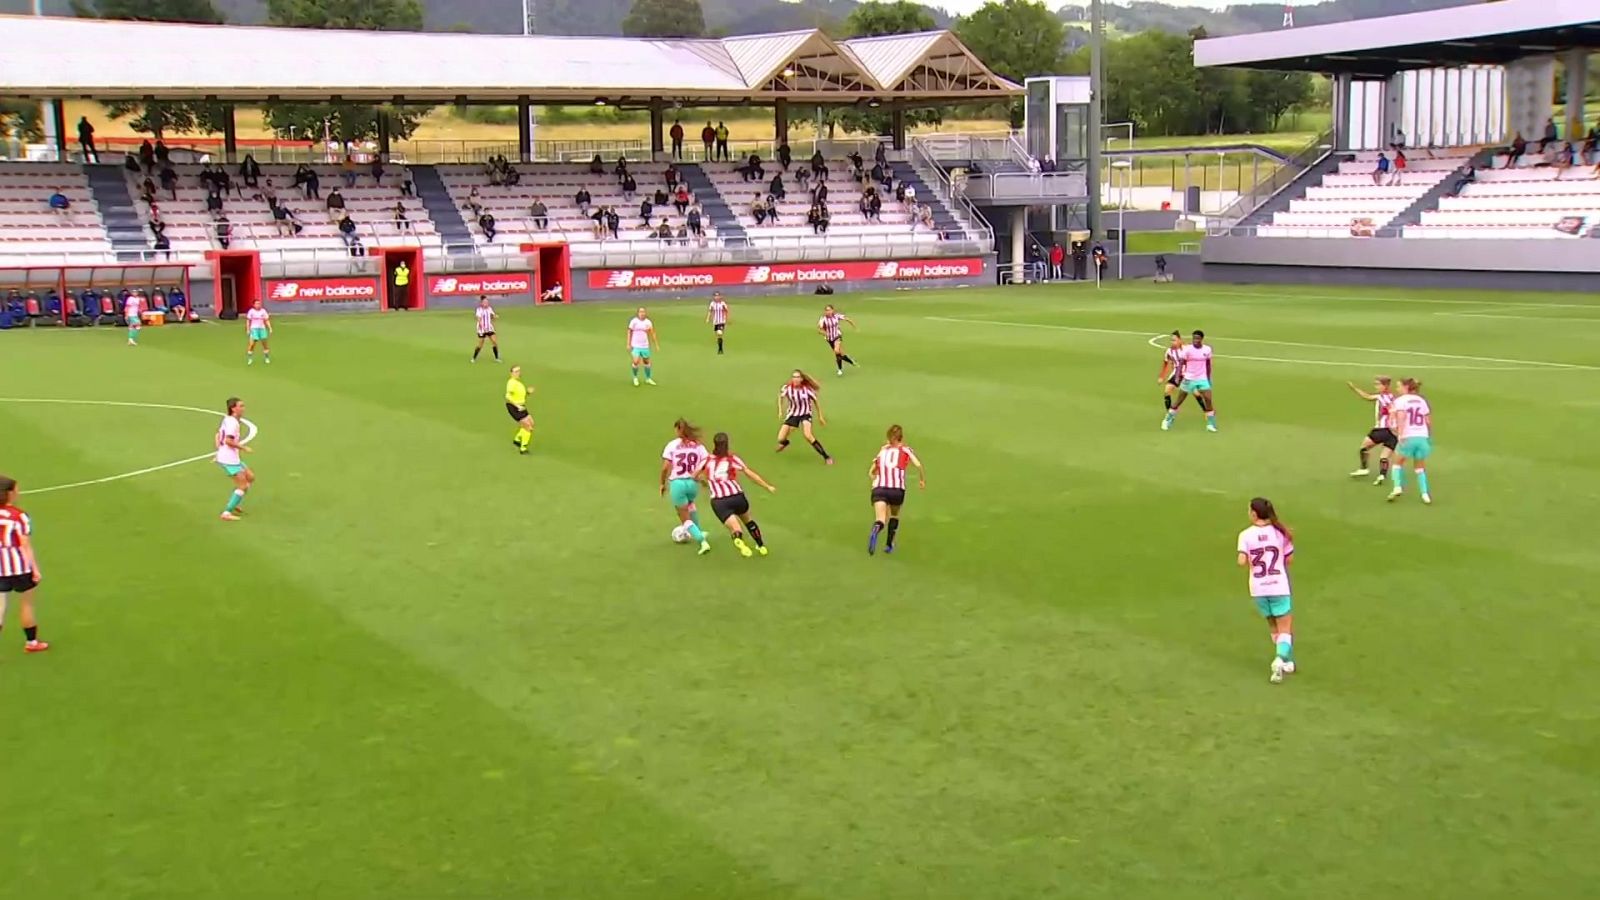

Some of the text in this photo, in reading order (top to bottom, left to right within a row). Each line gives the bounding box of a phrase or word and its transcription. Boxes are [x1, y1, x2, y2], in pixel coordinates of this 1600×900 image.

[771, 272, 795, 282] new
[797, 269, 845, 280] balance
[899, 267, 922, 277] new
[923, 264, 969, 275] balance
[458, 283, 481, 292] new
[482, 280, 527, 291] balance
[635, 276, 660, 286] new
[662, 273, 713, 285] balance
[299, 288, 323, 297] new
[325, 285, 374, 296] balance
[1407, 406, 1424, 426] 16
[675, 452, 698, 476] 38
[1250, 546, 1281, 578] 32
